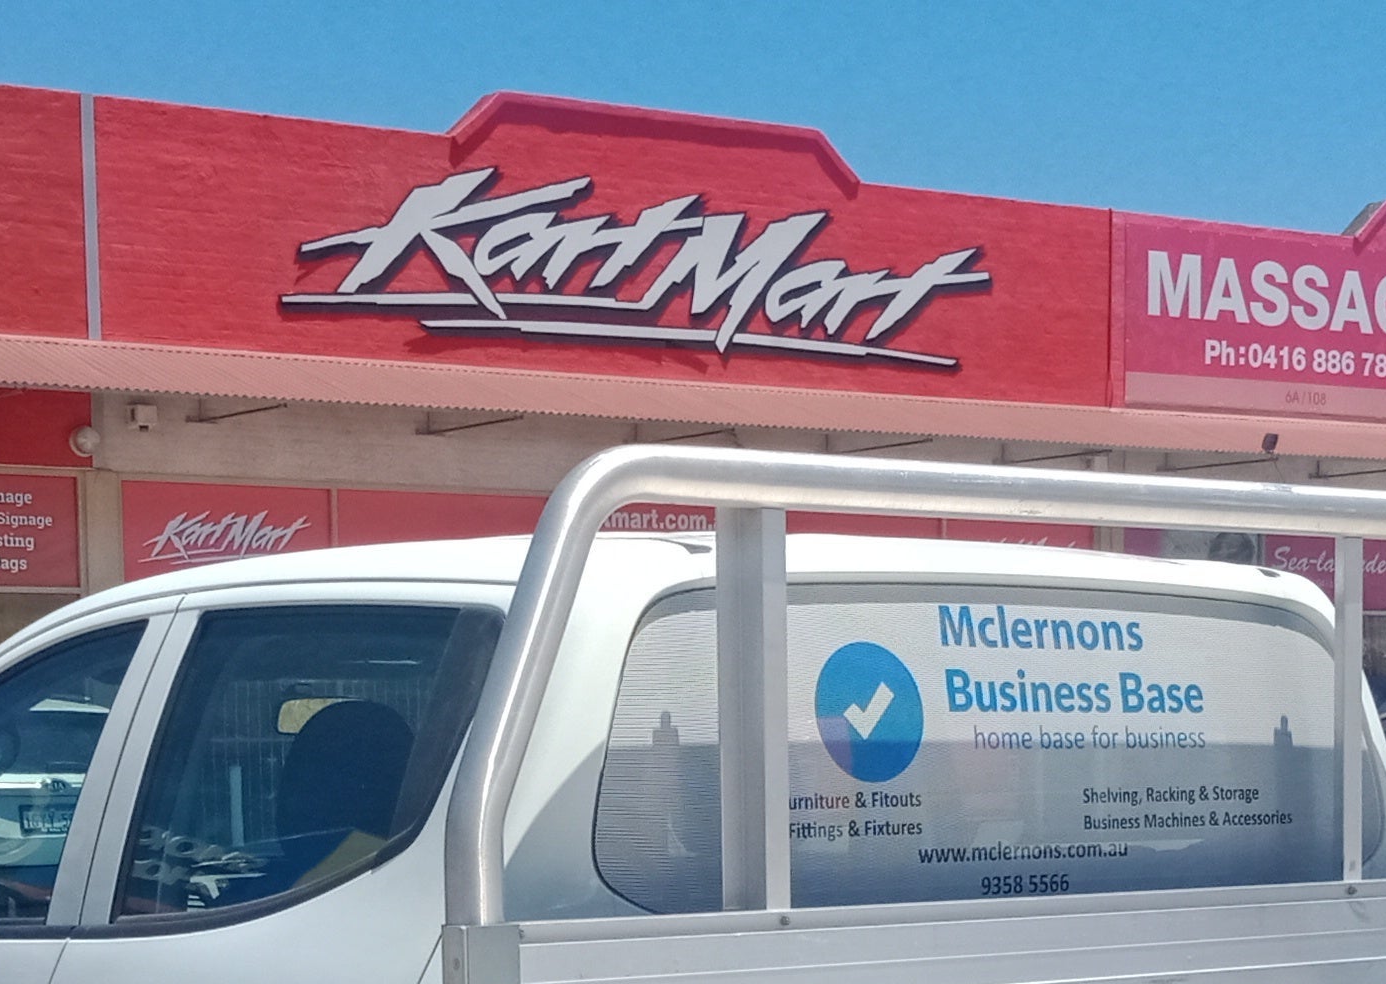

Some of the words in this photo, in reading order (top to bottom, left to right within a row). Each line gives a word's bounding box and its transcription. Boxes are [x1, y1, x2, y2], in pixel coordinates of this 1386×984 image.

[1312, 349, 1355, 376] 886
[940, 605, 1143, 652] Mclernons
[945, 668, 1111, 714] Business
[1120, 673, 1203, 715] Base
[973, 726, 1033, 750] home
[1039, 725, 1084, 749] base
[1092, 725, 1121, 749] for
[1126, 724, 1206, 749] business
[789, 793, 850, 810] urniture
[855, 792, 866, 808] &
[871, 792, 922, 808] Fitouts
[1082, 787, 1143, 806] Shelving,
[1146, 786, 1195, 805] Racking
[1198, 787, 1211, 801] &
[1213, 785, 1259, 804] Storage
[789, 822, 843, 842] Fittings
[848, 820, 860, 837] &
[864, 819, 923, 836] Fixtures
[1083, 814, 1140, 831] Business
[1144, 812, 1206, 829] Machines
[1209, 812, 1220, 827] &
[1223, 810, 1293, 826] Accessories
[918, 841, 1128, 865] www.mclernons.com.au
[981, 875, 1023, 896] 9358
[1028, 874, 1070, 894] 5566
